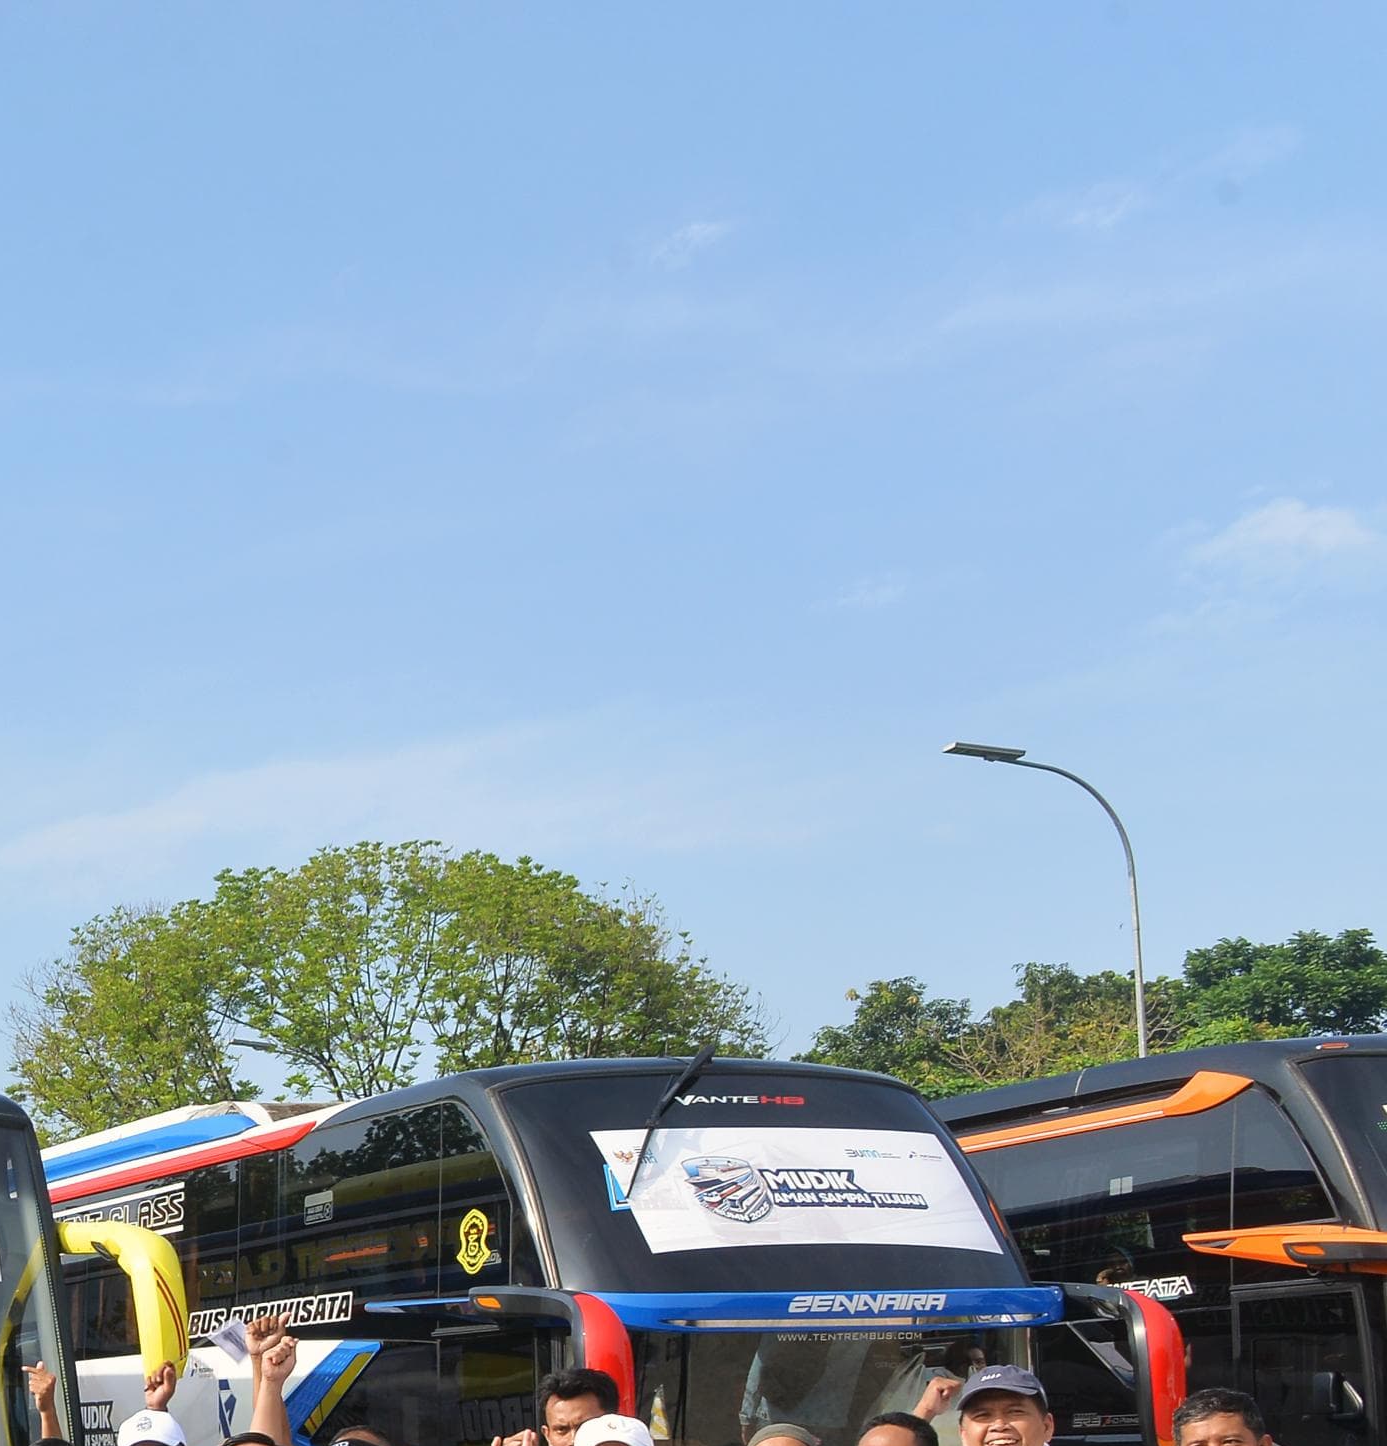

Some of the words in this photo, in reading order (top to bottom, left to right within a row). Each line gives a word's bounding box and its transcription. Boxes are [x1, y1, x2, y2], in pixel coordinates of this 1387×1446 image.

[675, 1094, 759, 1106] VANTE
[764, 1170, 854, 1190] MUDIK
[773, 1192, 818, 1204] AMAN
[821, 1192, 870, 1204] SAMPAI
[872, 1193, 926, 1206] TUJUAN
[110, 1191, 186, 1228] CLASS
[189, 1310, 225, 1337] BUS
[777, 1331, 923, 1342] WWW.TENTREMBUS.COM
[81, 1405, 111, 1430] UDIK
